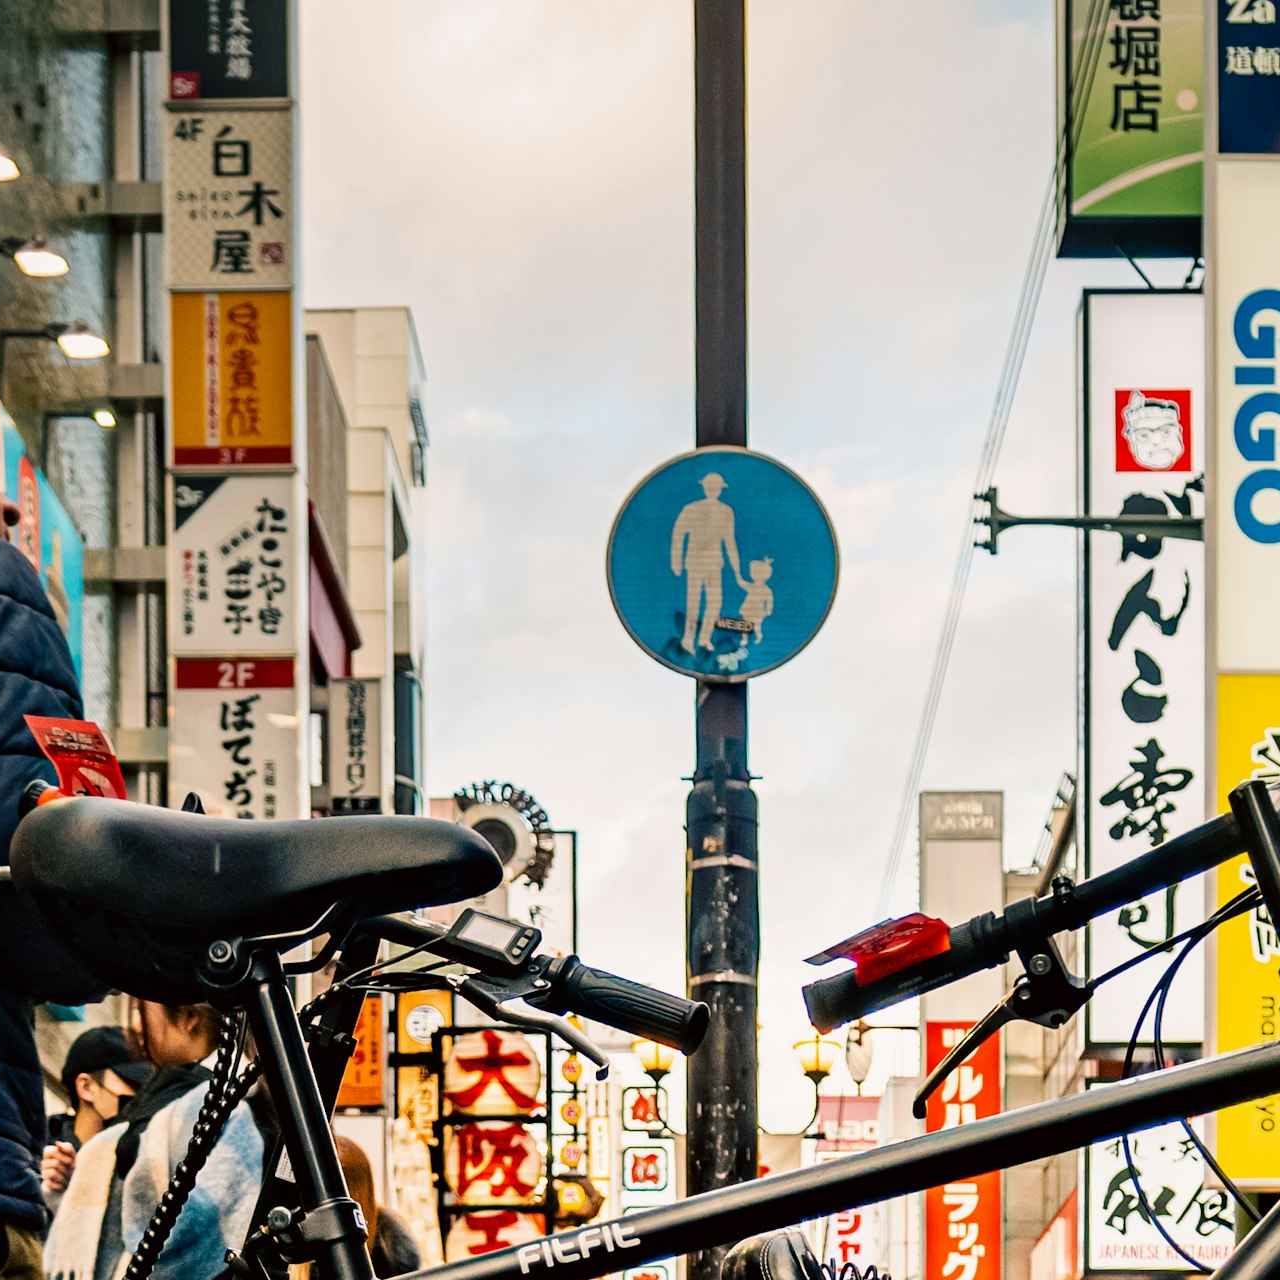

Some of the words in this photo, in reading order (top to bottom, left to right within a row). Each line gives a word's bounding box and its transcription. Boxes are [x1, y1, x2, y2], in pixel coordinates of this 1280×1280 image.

[174, 118, 204, 141] 4F
[210, 124, 285, 273] 白木屋
[217, 662, 255, 687] 2F
[1099, 1244, 1159, 1260] JAPANESE
